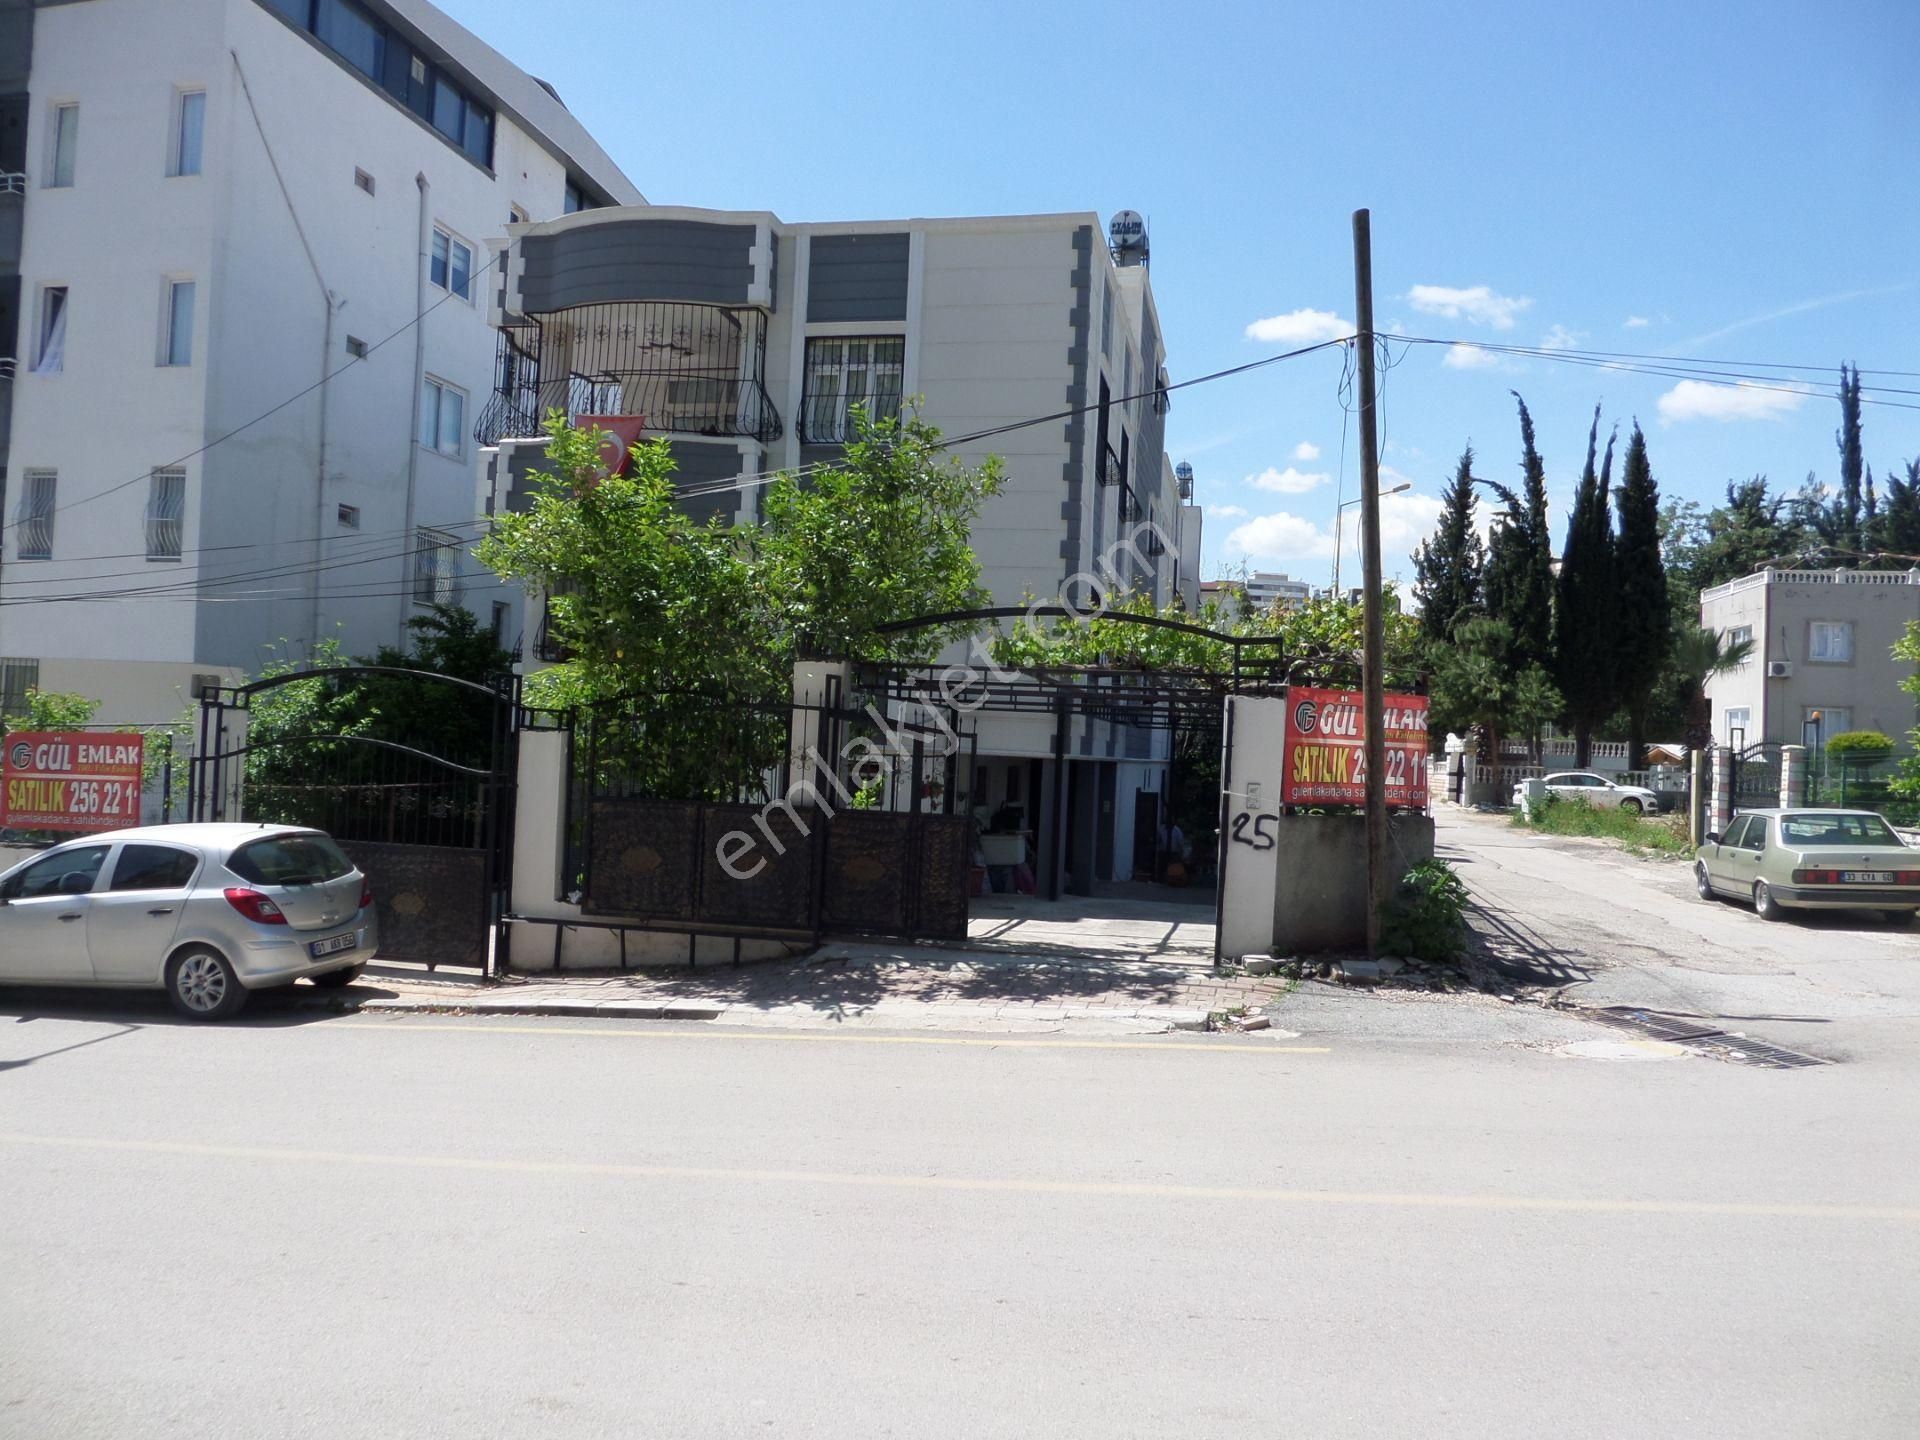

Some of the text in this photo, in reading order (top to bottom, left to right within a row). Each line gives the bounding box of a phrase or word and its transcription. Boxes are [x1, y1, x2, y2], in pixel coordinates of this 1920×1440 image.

[1320, 695, 1358, 736] GÜL
[36, 737, 139, 770] GÜL EMLAK
[1293, 745, 1350, 784] SATILIK
[1385, 750, 1405, 786] 22
[9, 779, 65, 812] SATILIK
[69, 781, 99, 813] 256
[102, 782, 120, 814] 22
[1232, 812, 1279, 850] 25
